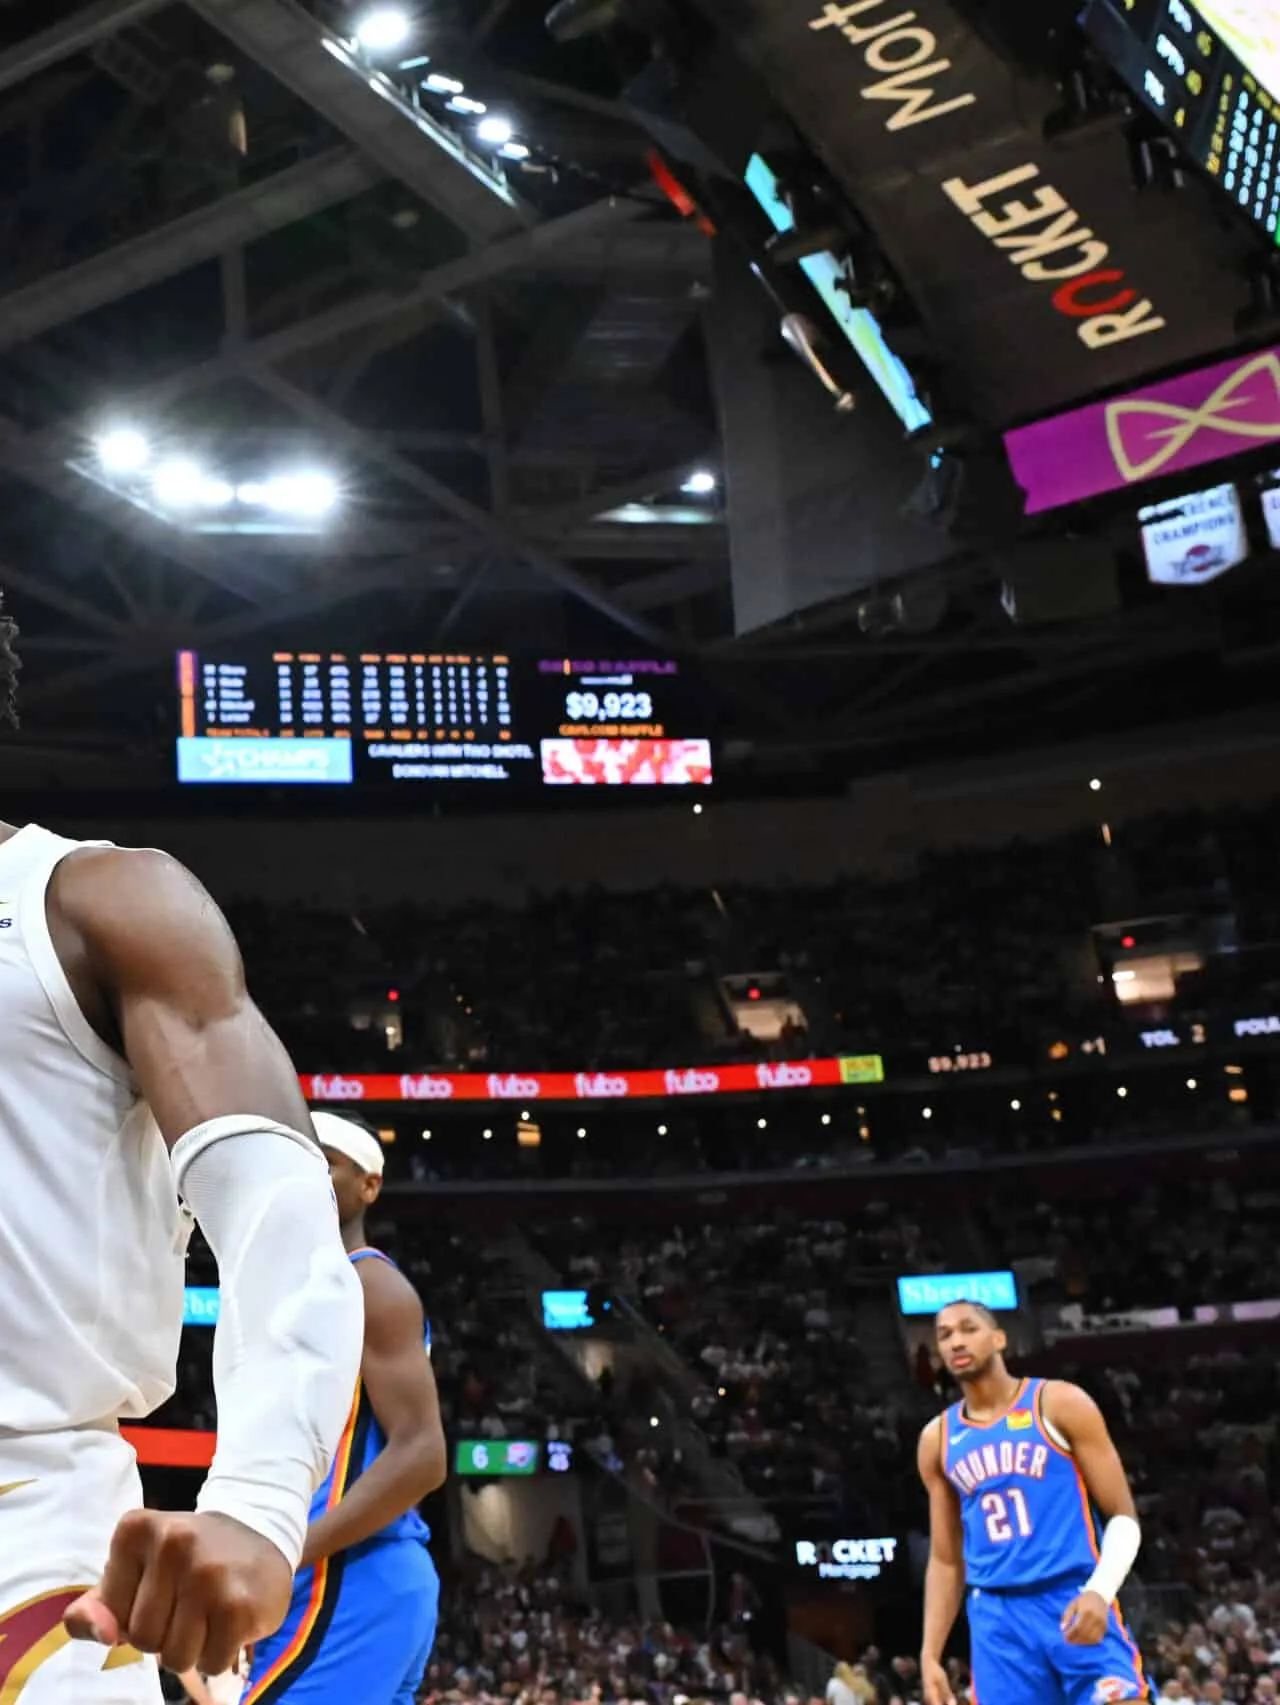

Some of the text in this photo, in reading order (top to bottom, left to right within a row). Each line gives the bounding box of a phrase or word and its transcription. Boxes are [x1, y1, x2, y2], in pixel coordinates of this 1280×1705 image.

[566, 691, 653, 721] $9,923
[312, 1062, 812, 1100] fubo fubo fubo fubo fubo fubo
[472, 1444, 489, 1470] 6
[949, 1440, 1049, 1495] THUNDER
[980, 1487, 1033, 1543] 21
